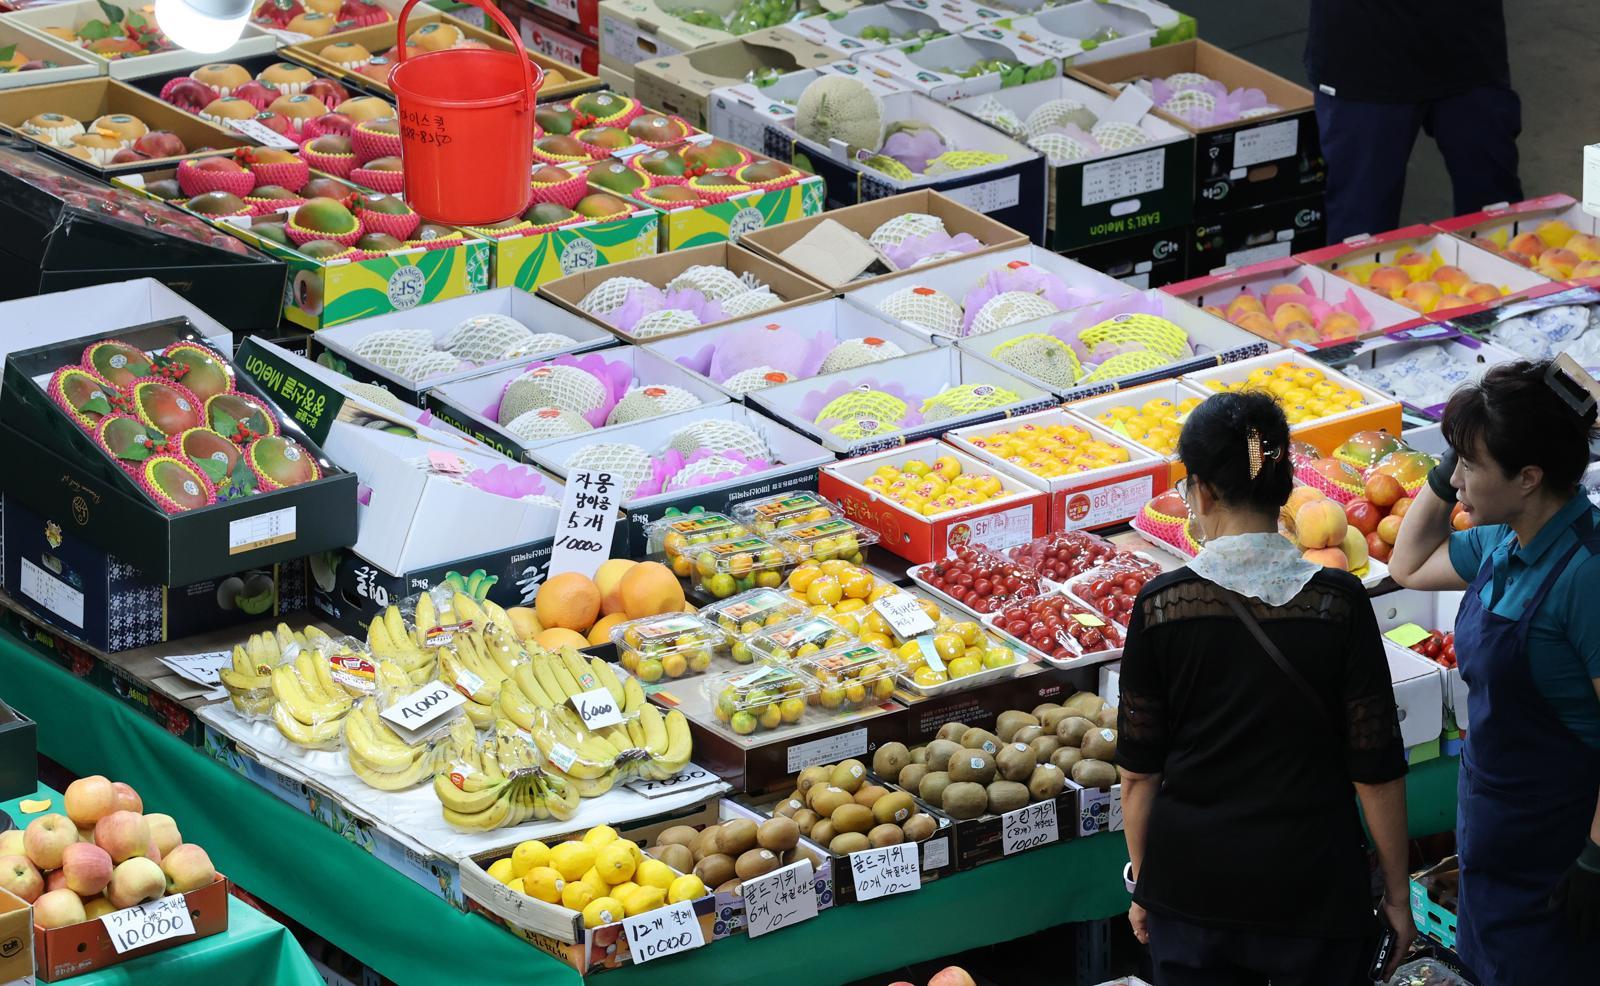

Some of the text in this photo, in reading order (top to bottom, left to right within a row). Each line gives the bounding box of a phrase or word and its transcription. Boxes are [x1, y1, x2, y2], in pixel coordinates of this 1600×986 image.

[1089, 211, 1161, 236] EARL'S Melon
[398, 279, 417, 296] SF
[244, 354, 326, 418] 청정산골 Melon
[575, 472, 615, 494] 자몽
[575, 492, 612, 511] 남아공
[1094, 494, 1107, 509] 38
[567, 511, 604, 532] 5개
[974, 524, 989, 537] 45
[555, 535, 603, 552] 10000
[411, 578, 429, 590] 8kg
[580, 699, 613, 722] 6000
[1010, 833, 1048, 851] 10000
[632, 917, 664, 942] 12개
